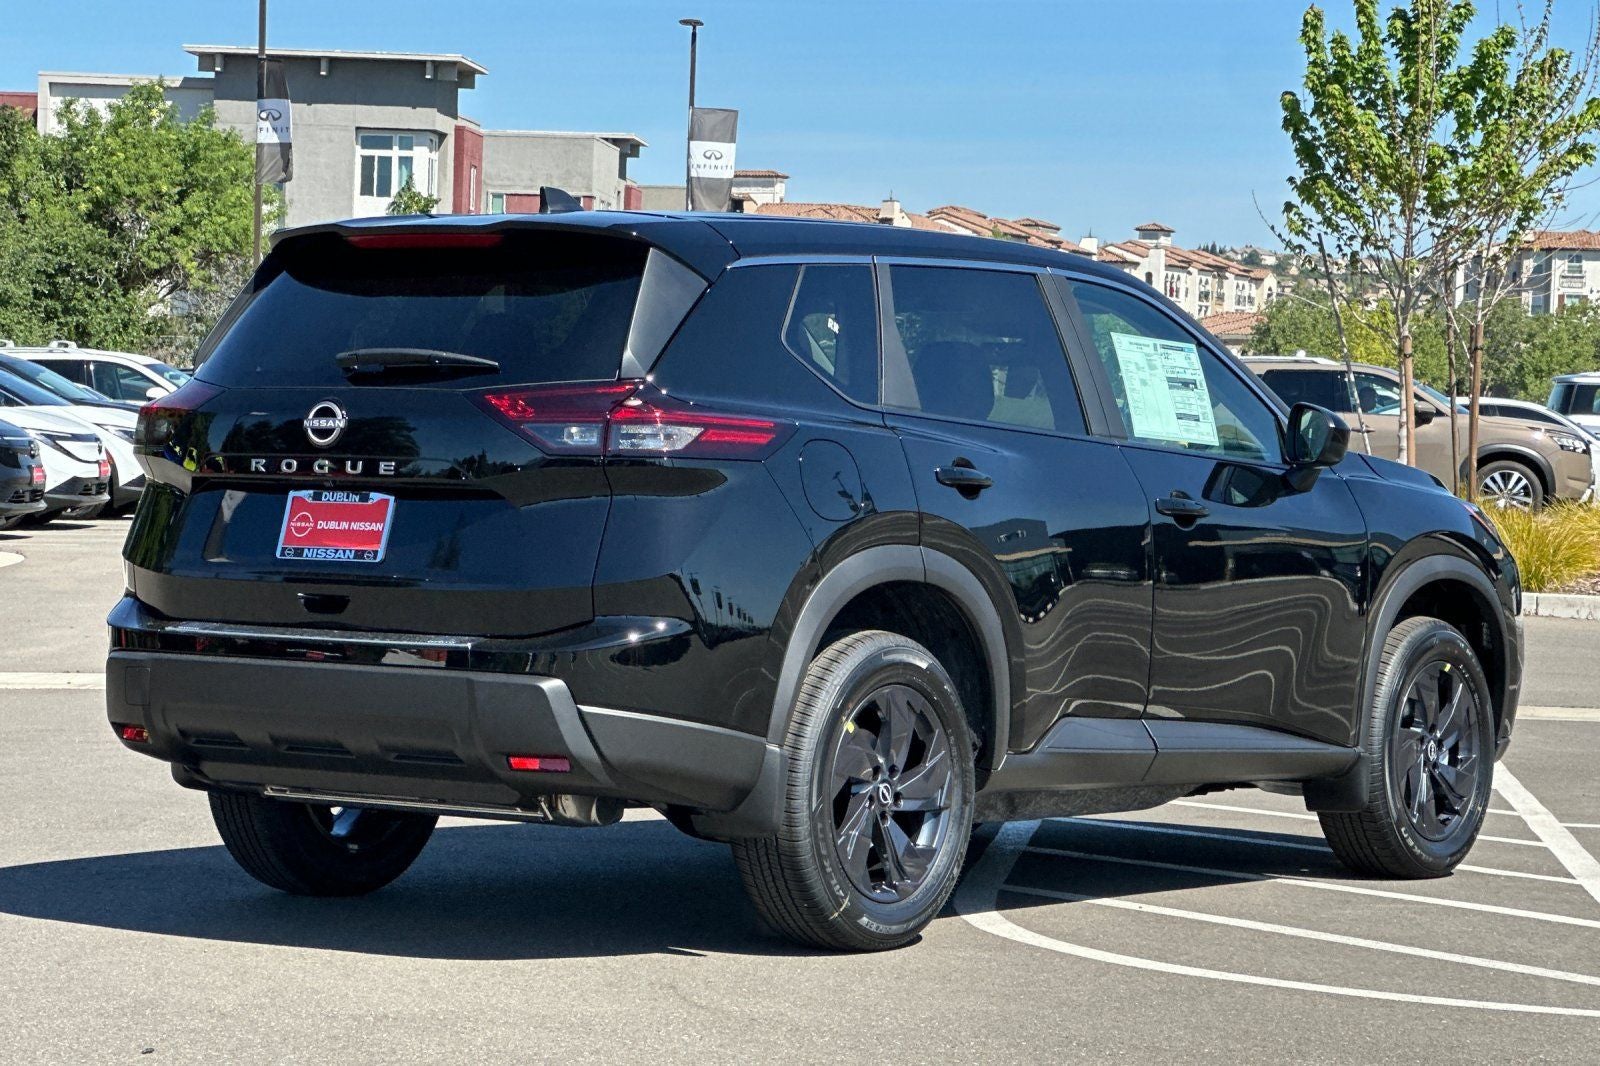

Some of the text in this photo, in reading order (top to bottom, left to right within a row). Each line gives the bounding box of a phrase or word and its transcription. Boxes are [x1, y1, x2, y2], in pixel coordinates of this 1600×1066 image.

[303, 419, 345, 428] NISSAN
[250, 458, 396, 475] ROGUE
[321, 491, 360, 502] DUBLIN
[317, 520, 384, 531] DUBLIN NISSAN
[302, 548, 355, 559] NISSAN
